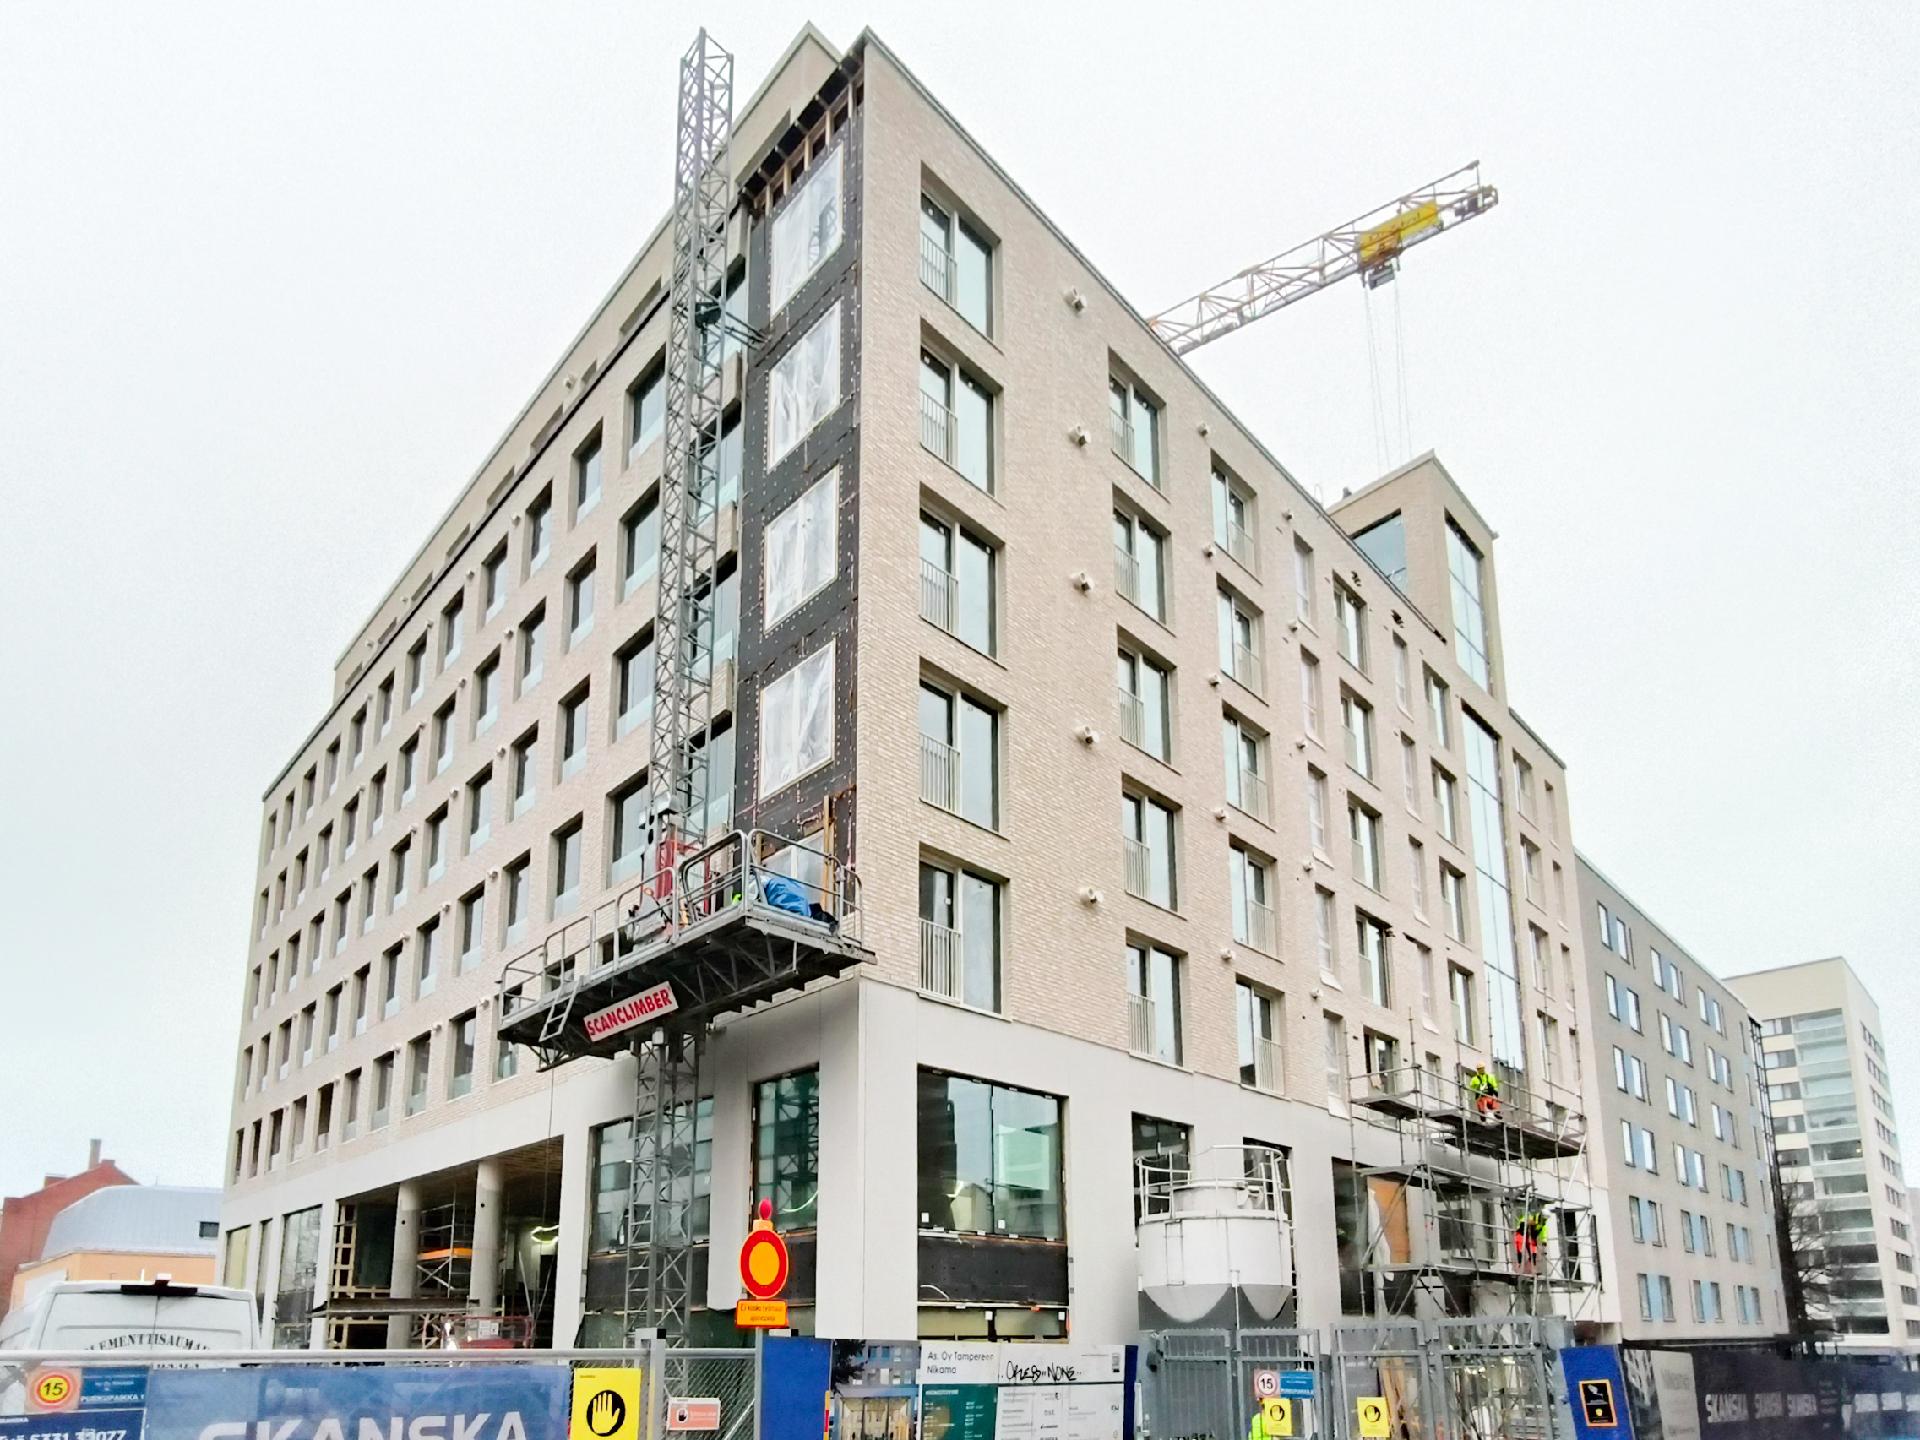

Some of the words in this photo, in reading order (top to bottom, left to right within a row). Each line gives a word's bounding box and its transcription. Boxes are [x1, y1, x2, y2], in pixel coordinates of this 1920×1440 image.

[587, 989, 672, 1035] SCANCLIMBER
[43, 1382, 64, 1396] 15
[1260, 1378, 1274, 1390] 15
[199, 1411, 528, 1440] SKANSKA
